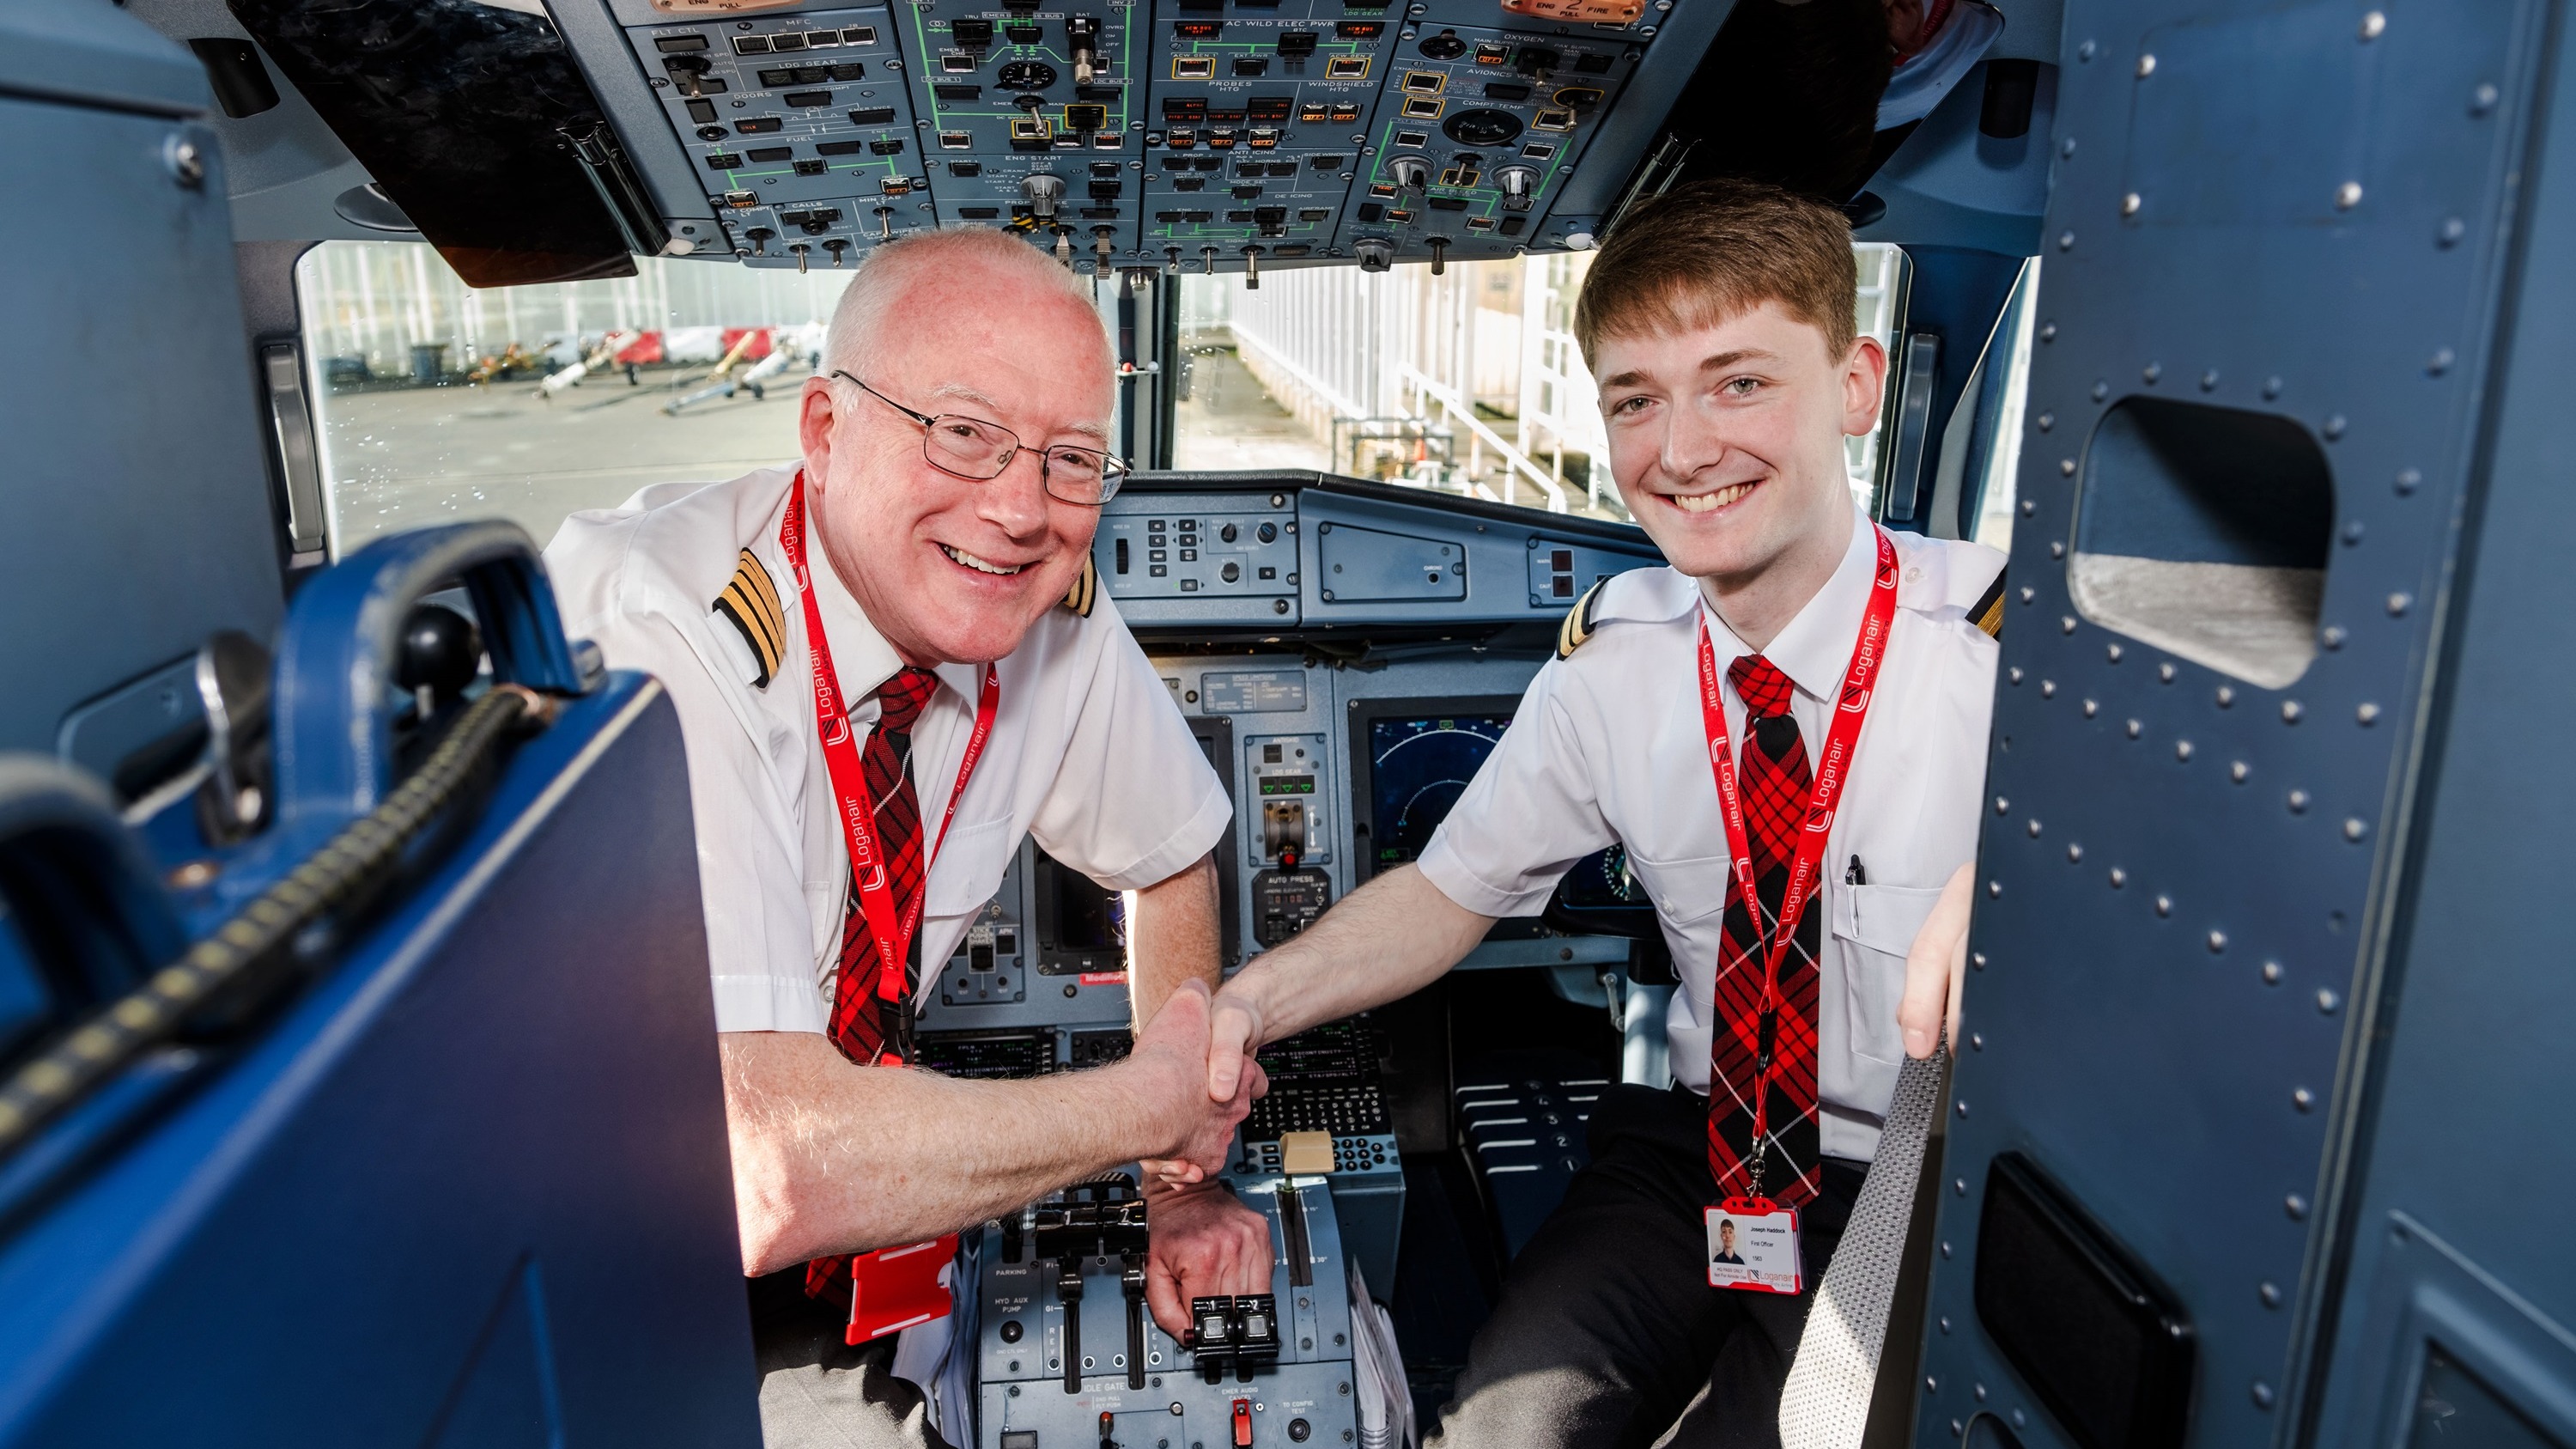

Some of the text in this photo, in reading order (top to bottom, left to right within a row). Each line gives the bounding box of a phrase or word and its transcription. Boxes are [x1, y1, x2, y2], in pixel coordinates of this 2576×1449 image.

[1566, 0, 1582, 9] 2
[1504, 33, 1545, 42] OXYGEN
[739, 205, 771, 214] COMPT
[1849, 614, 1880, 686] Loganair
[810, 645, 834, 719] Loganair
[1703, 643, 1718, 711] Loganair
[957, 722, 985, 789] Loganair
[1813, 738, 1844, 807] Loganair
[1721, 761, 1741, 831] Loganair
[846, 796, 871, 866] Loganair
[1783, 857, 1809, 922] Loganair
[1556, 1135, 1568, 1147] 2
[1566, 1160, 1574, 1172] 1
[1064, 1208, 1130, 1226] 1 2
[1759, 1271, 1794, 1282] Loganair
[1104, 1383, 1126, 1391] GATE
